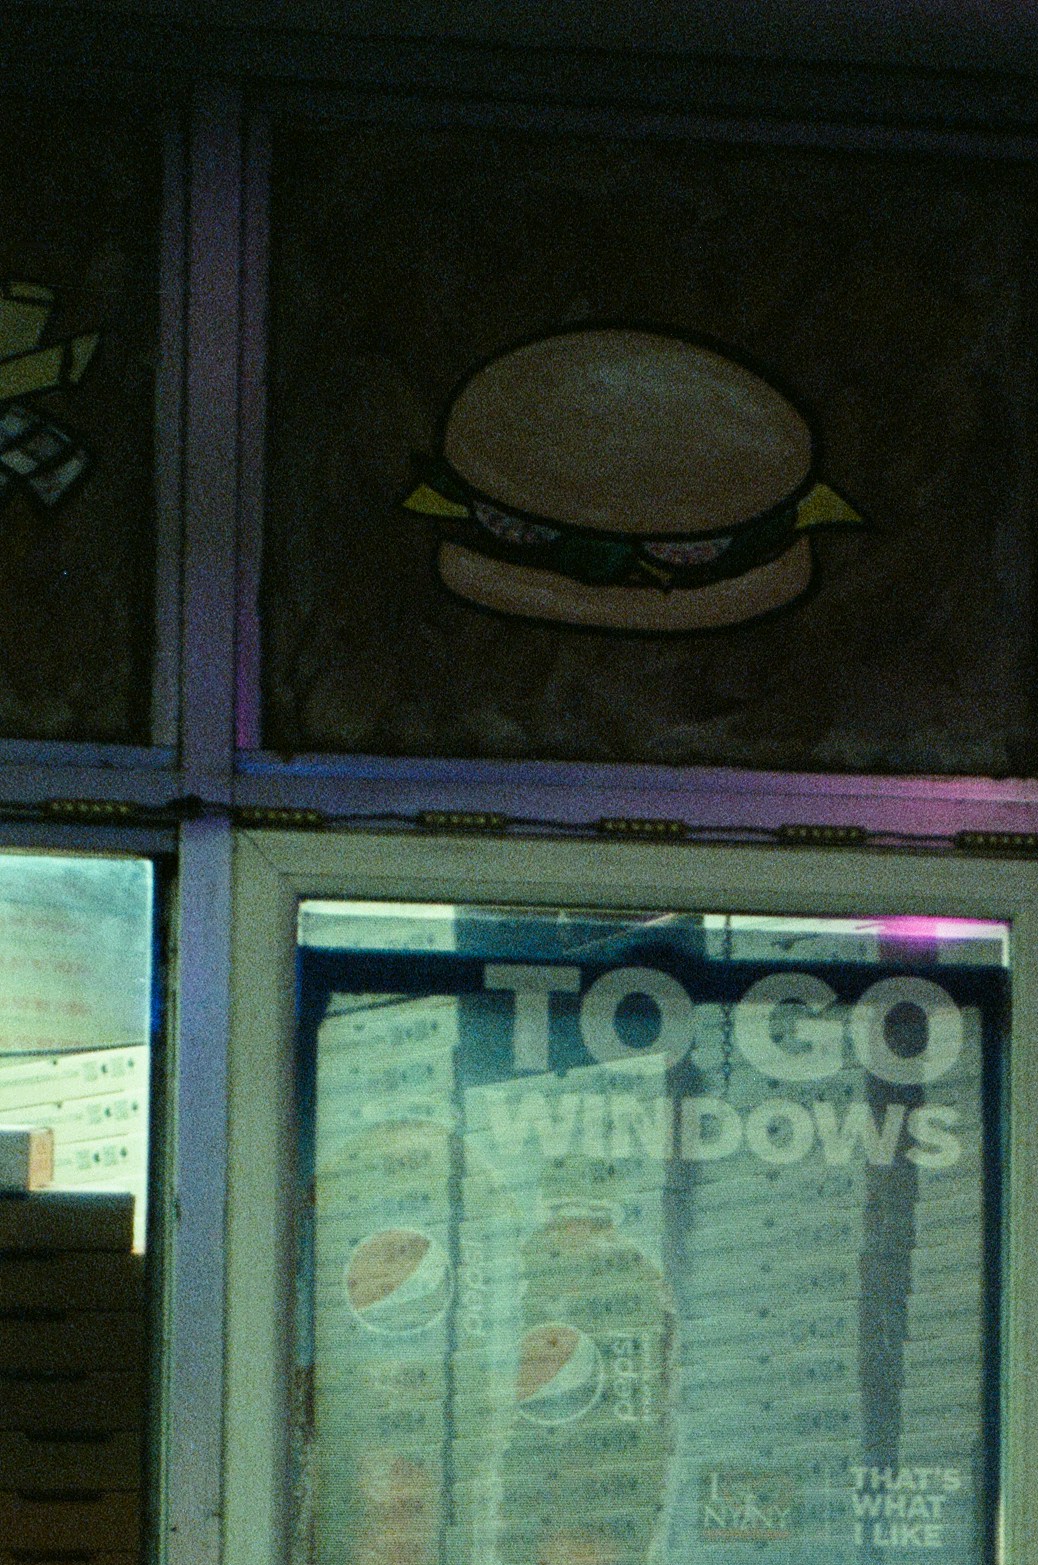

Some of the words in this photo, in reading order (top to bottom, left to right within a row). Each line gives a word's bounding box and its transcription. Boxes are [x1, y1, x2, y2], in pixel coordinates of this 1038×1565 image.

[484, 964, 697, 1074] TO
[733, 972, 964, 1084] GO
[487, 1093, 962, 1168] WINDOWS
[850, 1466, 961, 1491] THAT'S
[852, 1495, 946, 1518] WHAT
[853, 1522, 864, 1546] I
[872, 1522, 944, 1546] LIKE
